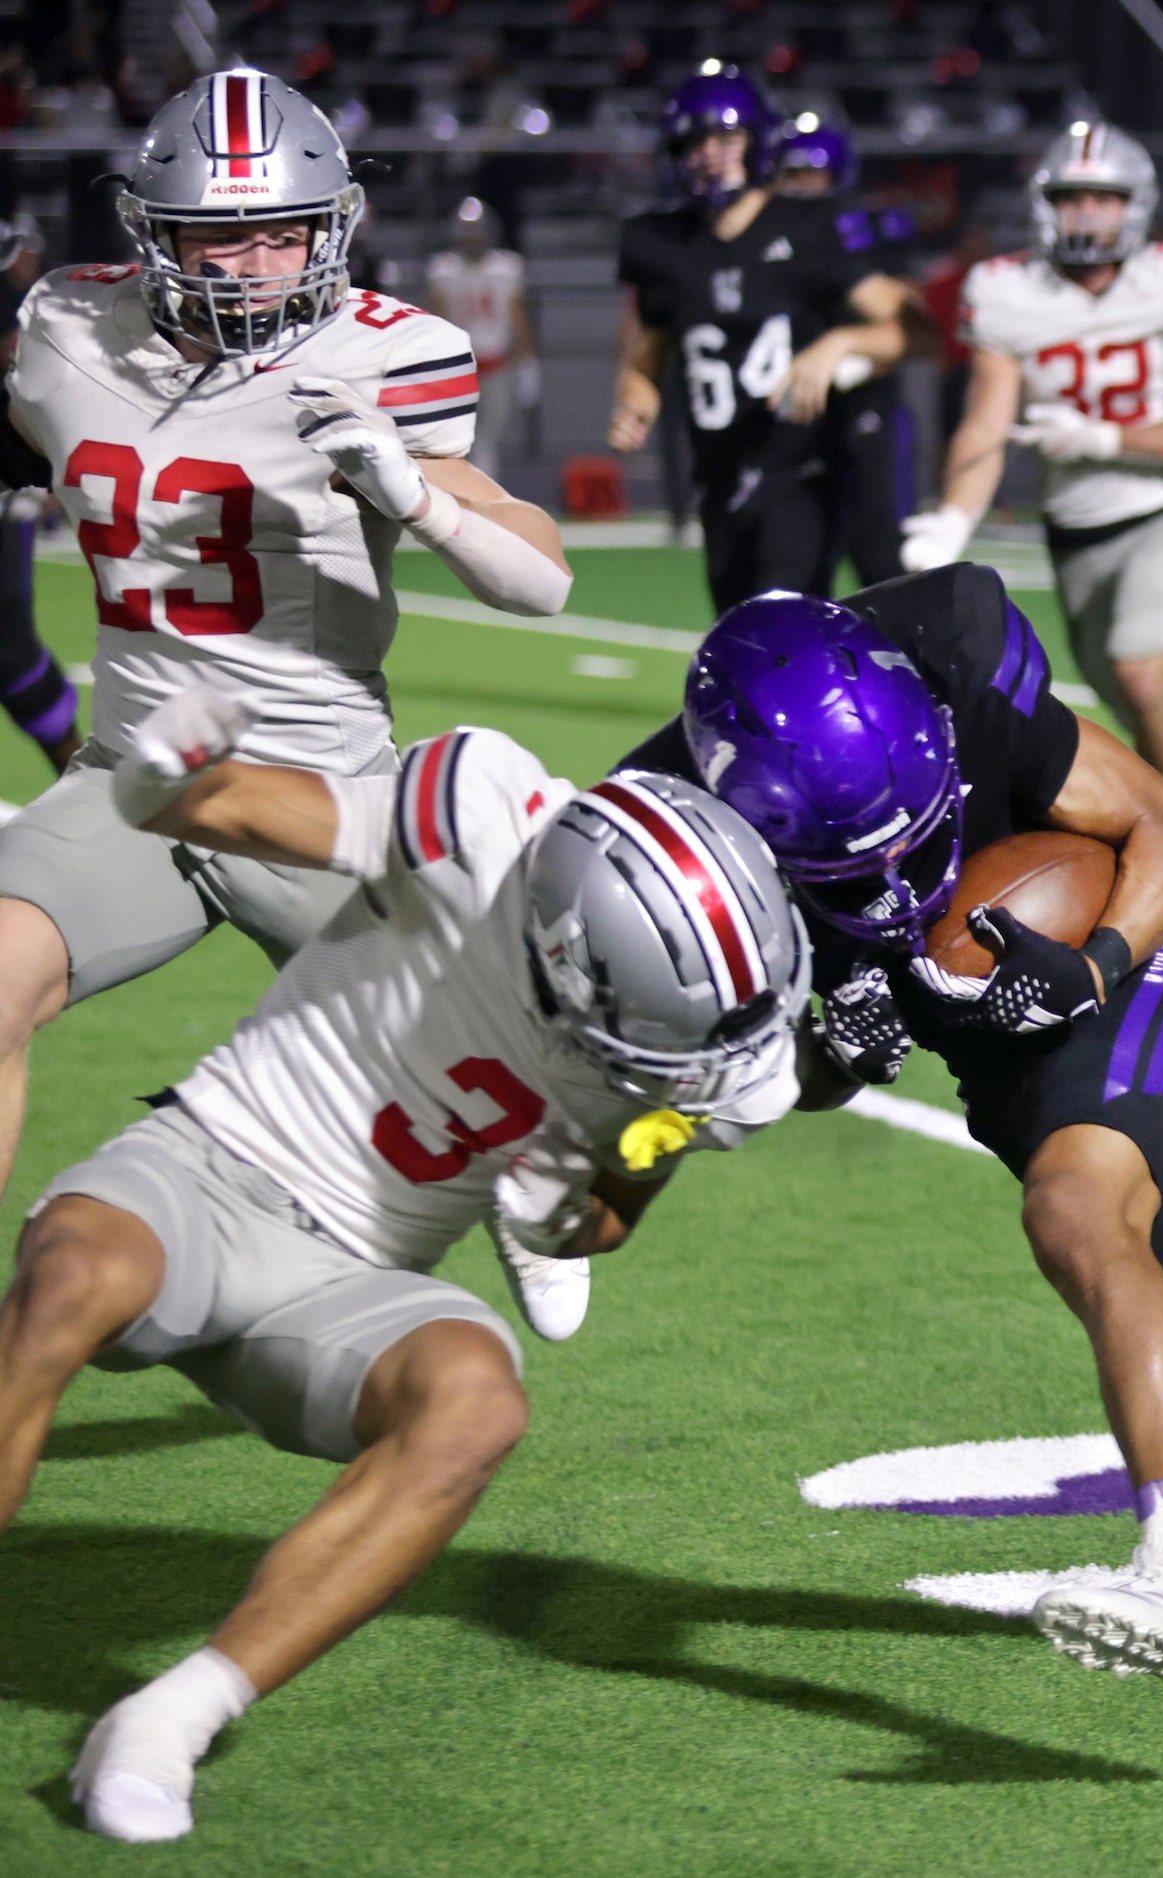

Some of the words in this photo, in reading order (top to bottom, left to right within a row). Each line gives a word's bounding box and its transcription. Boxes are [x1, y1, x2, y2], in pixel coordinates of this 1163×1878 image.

[683, 315, 793, 431] 64
[1037, 340, 1148, 426] 32
[64, 439, 264, 636] 23
[371, 1056, 545, 1184] 3
